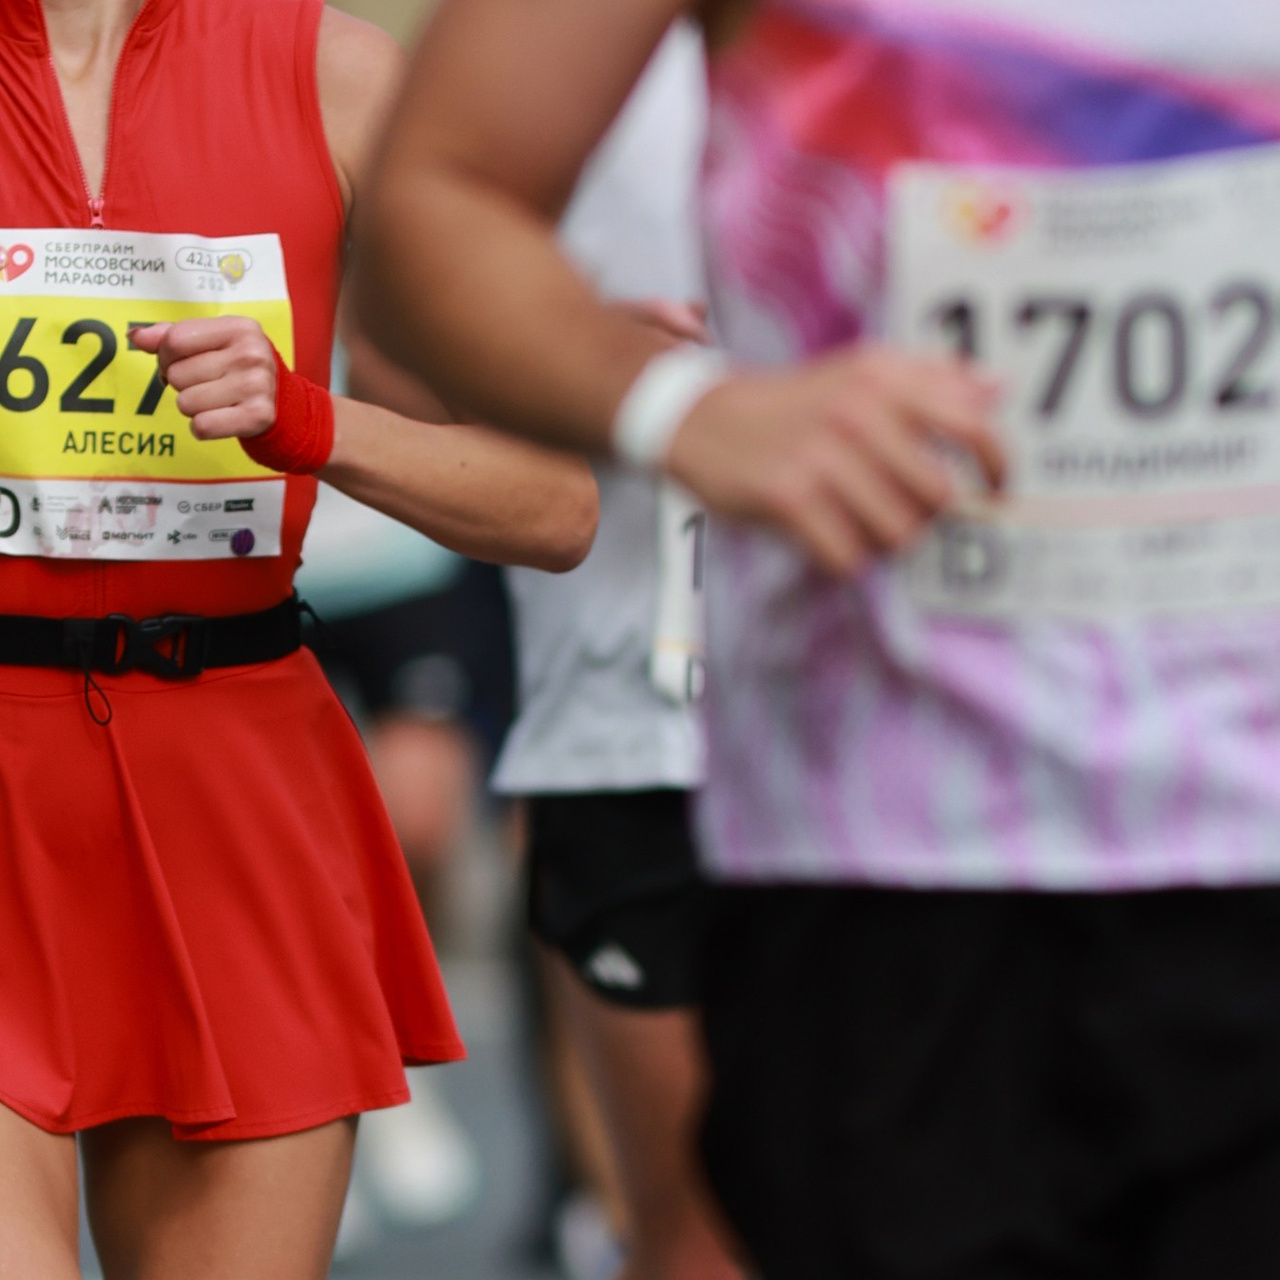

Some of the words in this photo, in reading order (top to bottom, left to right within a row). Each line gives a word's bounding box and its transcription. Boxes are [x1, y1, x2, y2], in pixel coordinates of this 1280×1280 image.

[45, 241, 135, 255] СБЕРПРАЙМ
[44, 255, 166, 273] МОСКОВСКИЙ
[186, 252, 212, 268] 42,2
[44, 271, 134, 286] МАРАФОН
[196, 276, 237, 291] 202
[62, 429, 176, 457] АЛЕСИЯ
[193, 502, 222, 512] СБЕР
